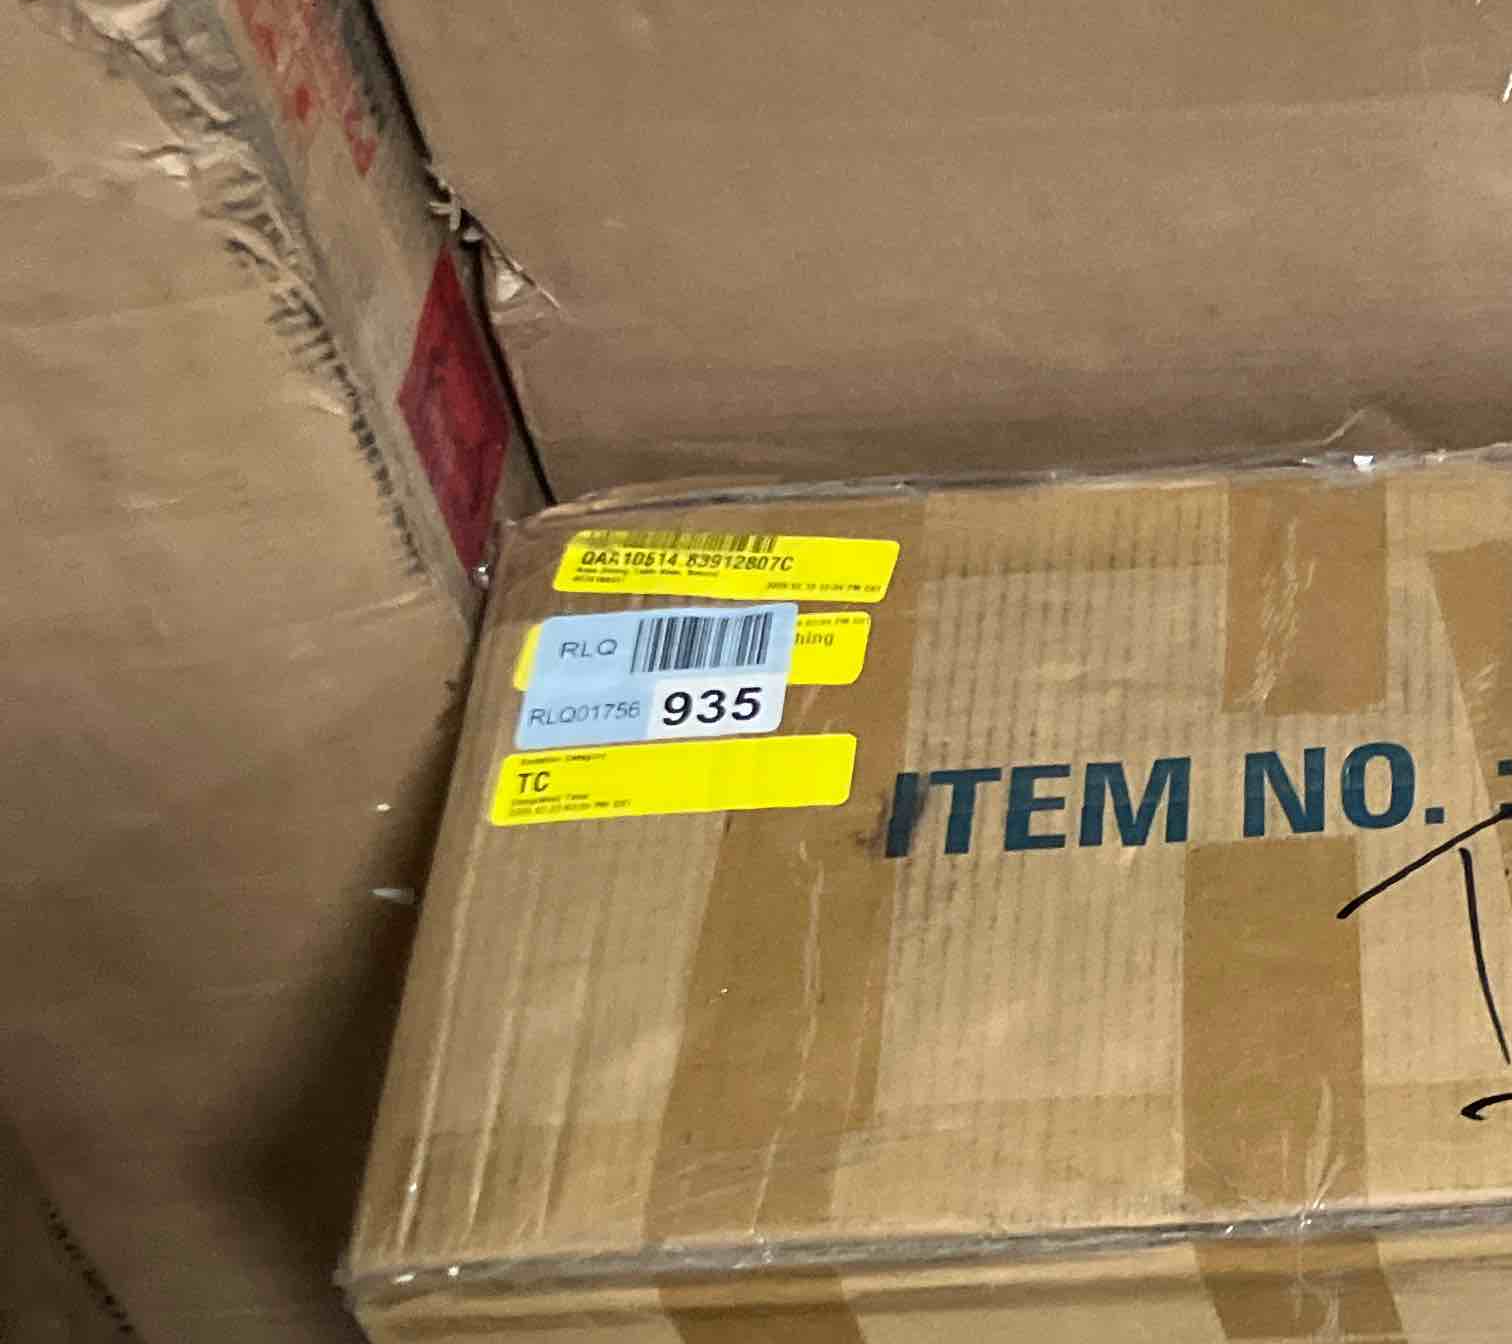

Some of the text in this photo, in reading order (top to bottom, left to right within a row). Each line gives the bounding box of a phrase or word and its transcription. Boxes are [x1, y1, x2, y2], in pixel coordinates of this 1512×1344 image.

[560, 638, 618, 658] RLQ
[527, 686, 763, 727] RLQ01756 935
[517, 770, 550, 794] TC
[884, 756, 1192, 858] ITEM
[1242, 740, 1445, 838] NO.
